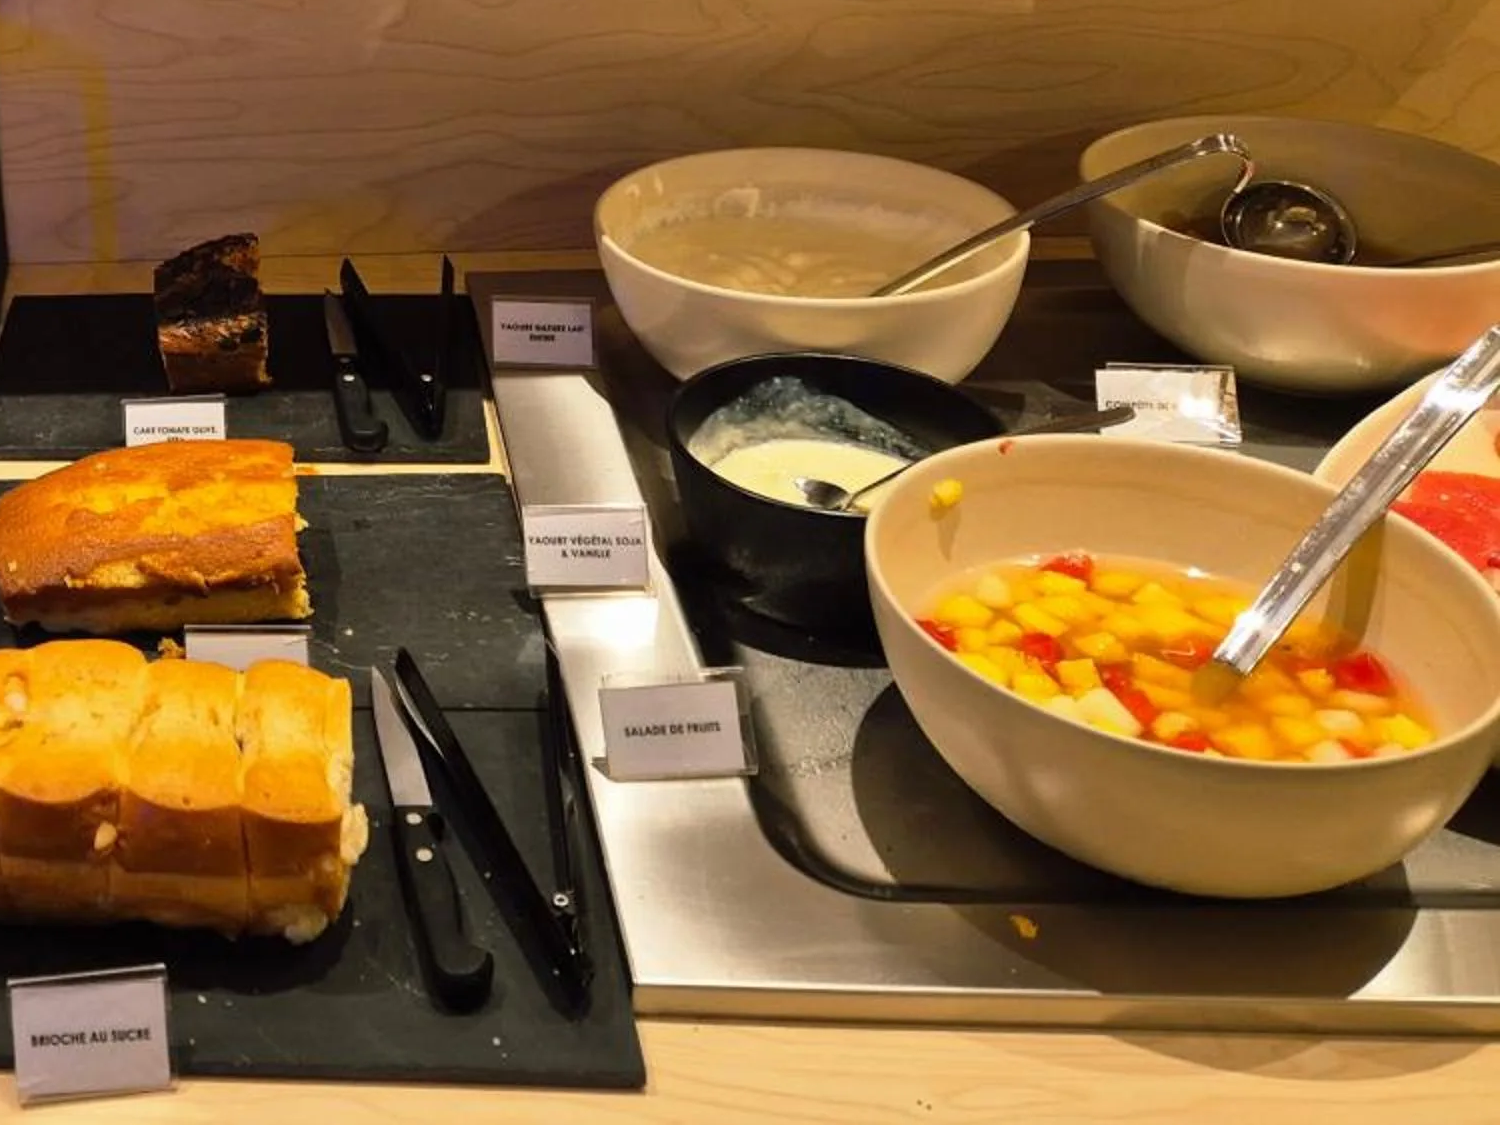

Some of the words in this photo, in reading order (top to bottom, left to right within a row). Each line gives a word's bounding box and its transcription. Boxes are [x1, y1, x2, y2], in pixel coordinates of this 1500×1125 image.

[528, 536, 568, 546] YAOURT
[570, 533, 613, 546] VÉGÉTAL
[615, 536, 643, 546] SOJA
[624, 724, 667, 738] SALADE
[669, 722, 685, 736] DE
[687, 720, 721, 734] FRUITS
[30, 1031, 87, 1048] BRIOCHE
[89, 1030, 109, 1045] AU
[111, 1027, 151, 1043] SUCRE
